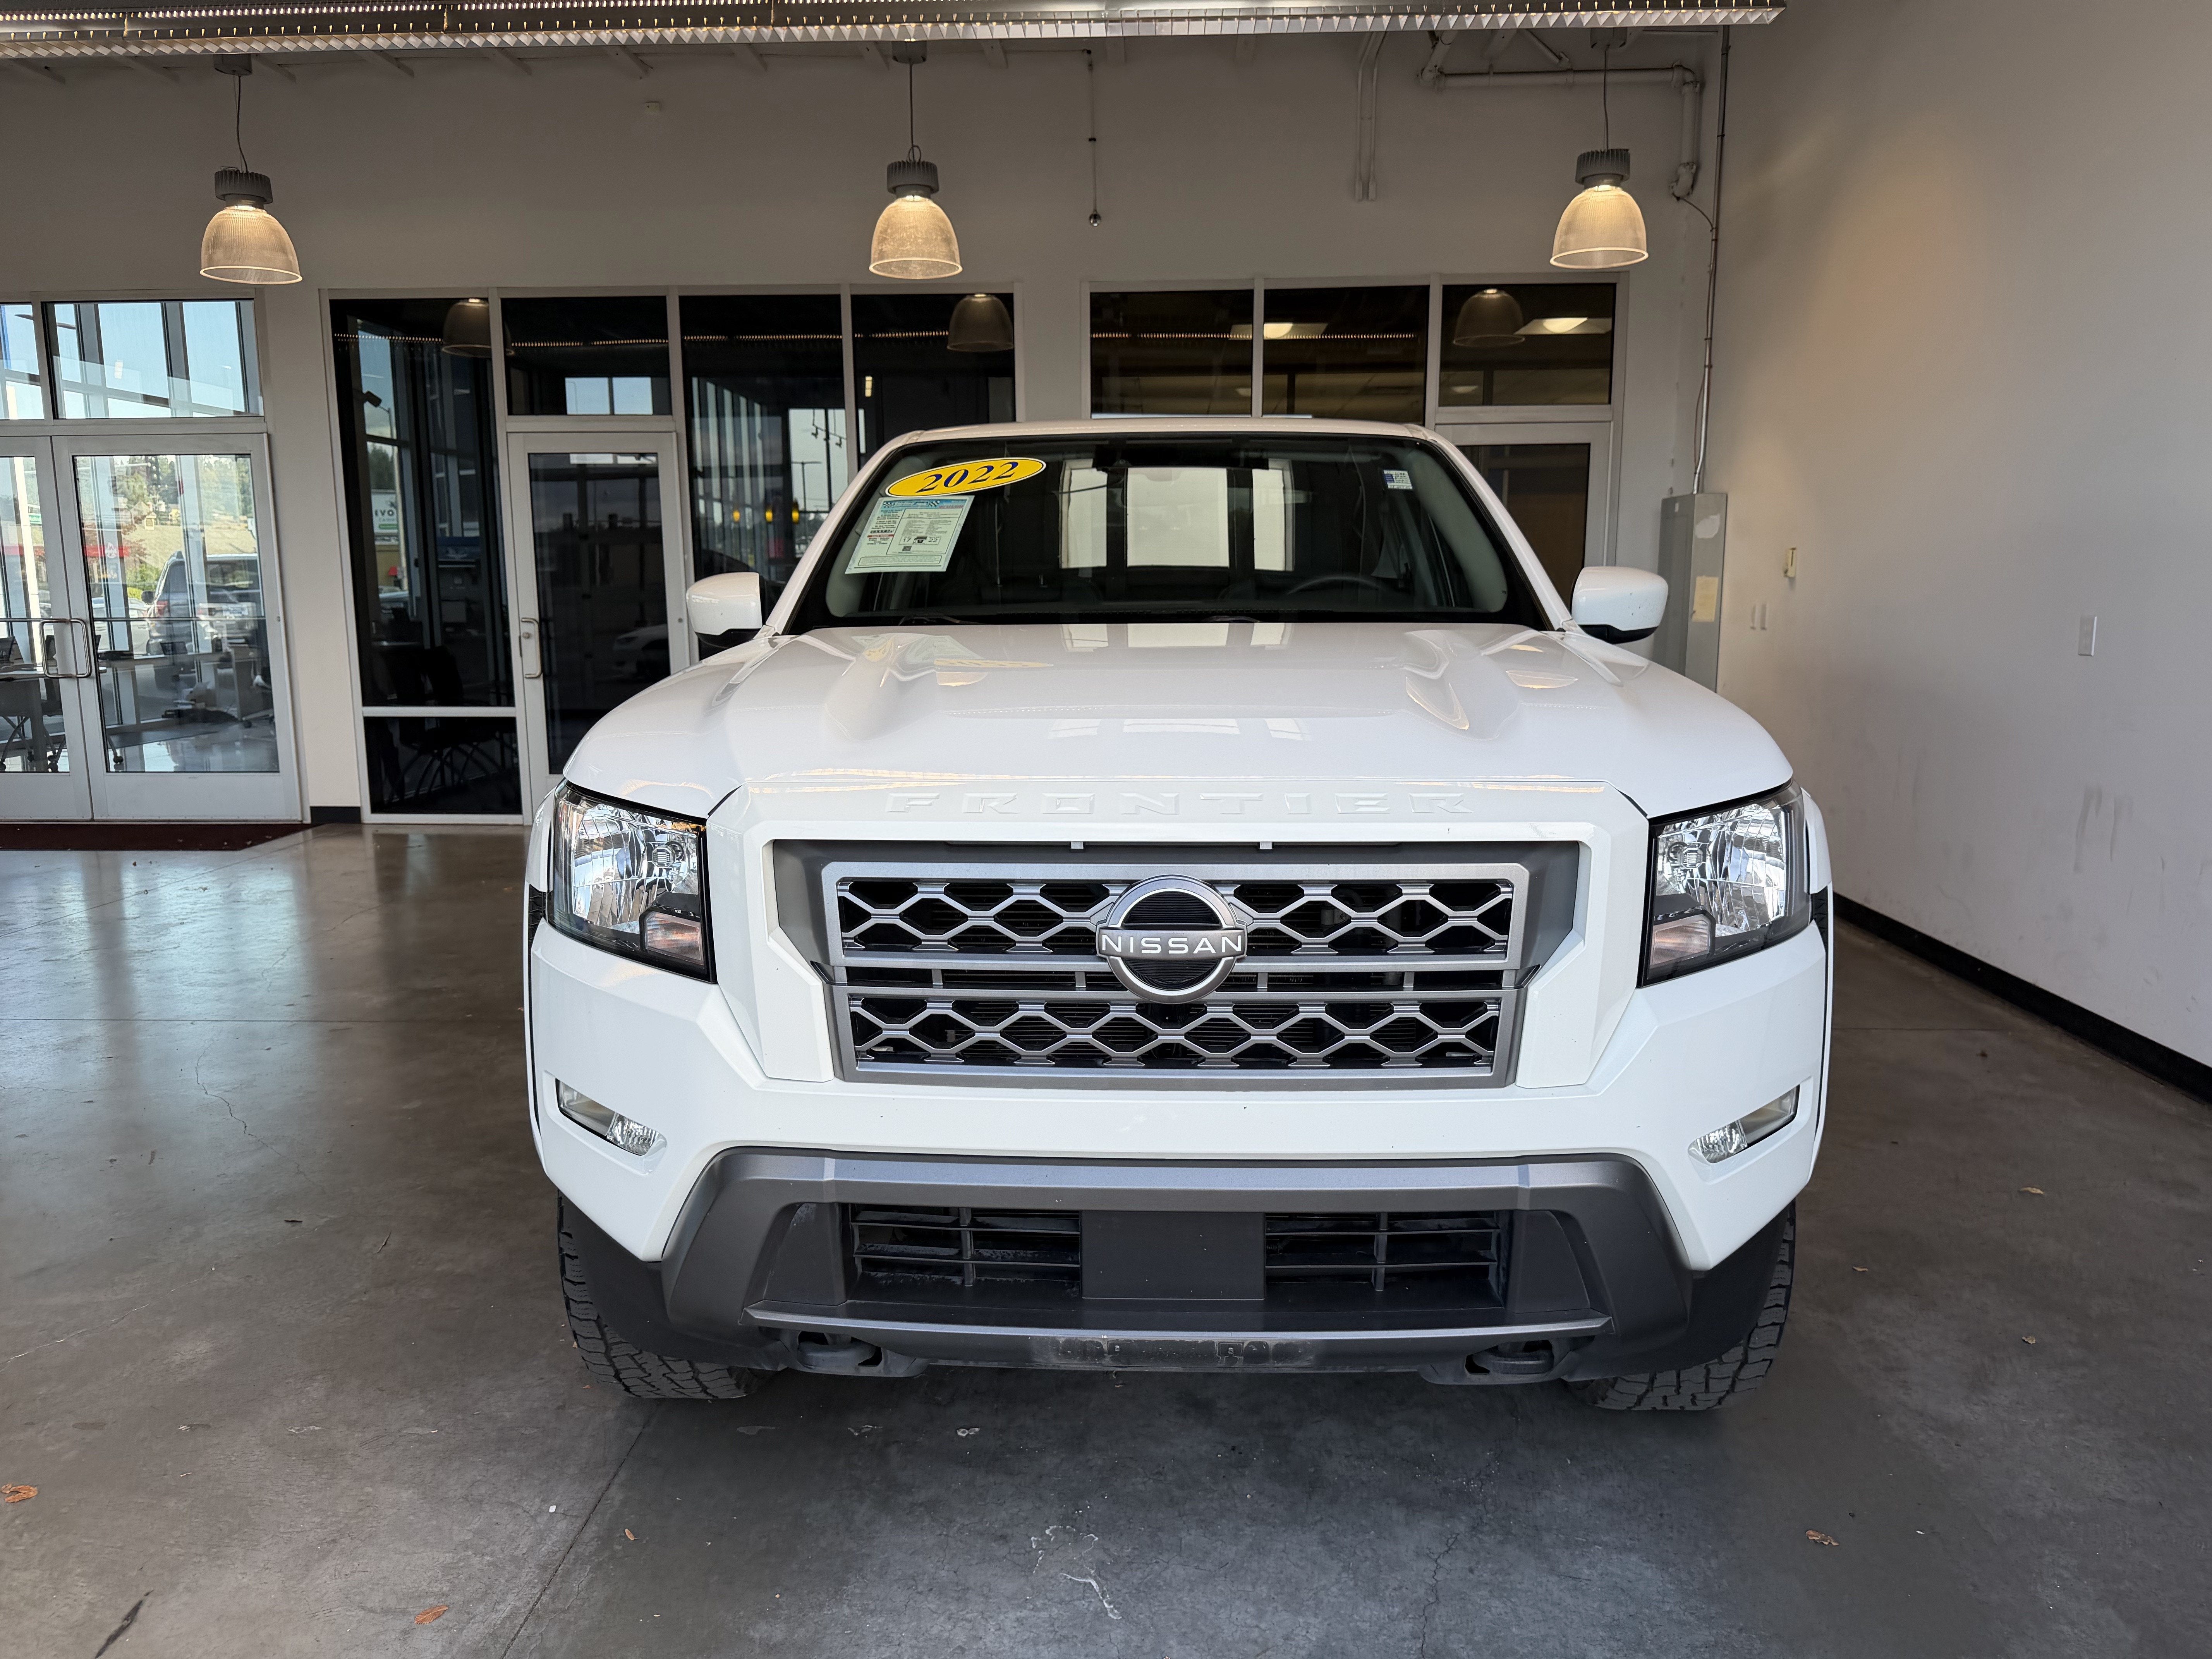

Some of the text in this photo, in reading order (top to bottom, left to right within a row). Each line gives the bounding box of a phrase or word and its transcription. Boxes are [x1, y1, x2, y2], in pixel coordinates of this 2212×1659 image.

[915, 461, 1019, 493] 2022
[885, 792, 1474, 815] FRONTIER
[1102, 934, 1242, 954] NISSAN
